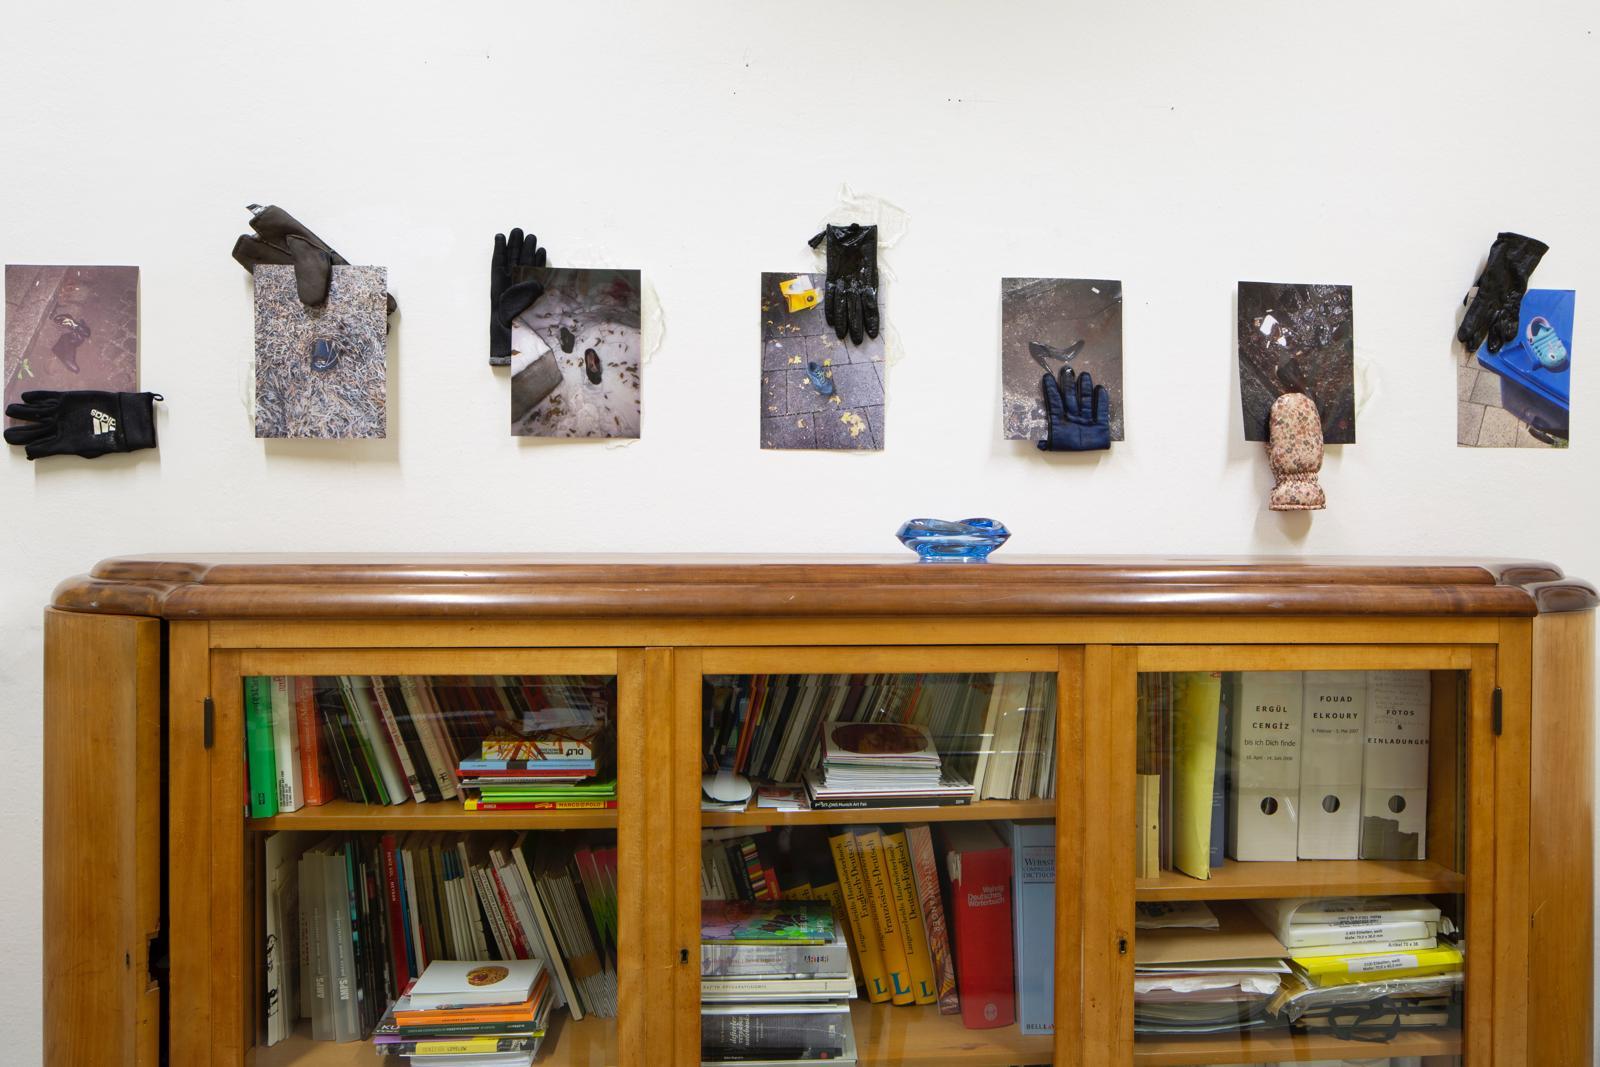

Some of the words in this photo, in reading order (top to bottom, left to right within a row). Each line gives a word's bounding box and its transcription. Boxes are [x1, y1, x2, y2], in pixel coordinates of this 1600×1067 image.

[90, 408, 117, 426] didas
[1319, 695, 1353, 703] FOUAD
[1255, 704, 1288, 713] ERGÜL
[1244, 738, 1254, 746] bis
[1254, 738, 1264, 746] ich
[1265, 738, 1279, 747] Dich
[1280, 738, 1296, 747] finde
[846, 840, 869, 918] Englisch-Deutsch
[867, 839, 894, 934] Französisch-Deutsch
[896, 841, 919, 920] Deutsch-Englisch
[339, 979, 350, 1000] AMPS
[873, 977, 888, 995] L
[889, 972, 911, 995] L
[919, 981, 934, 998] L
